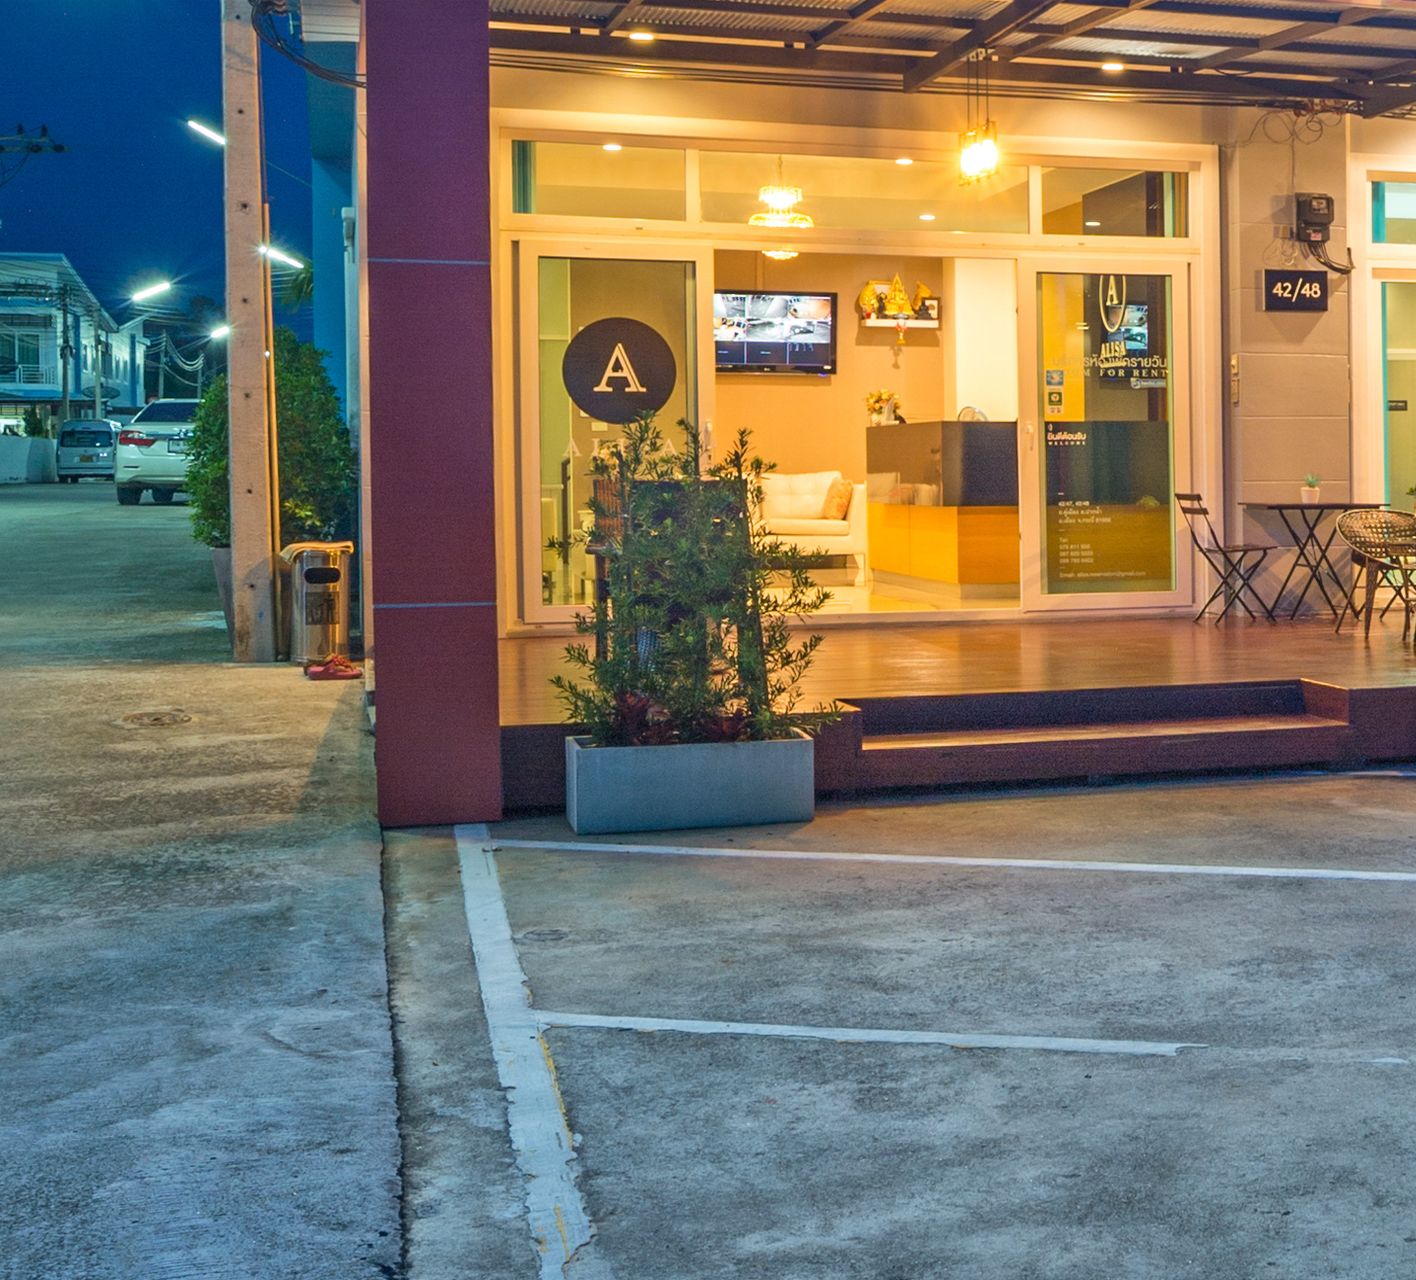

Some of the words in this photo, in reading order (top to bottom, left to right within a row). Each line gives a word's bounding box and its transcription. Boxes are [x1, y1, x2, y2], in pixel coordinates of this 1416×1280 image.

[1272, 277, 1321, 302] 42/48
[1100, 341, 1127, 359] ALISA
[592, 342, 647, 393] A
[1099, 368, 1125, 377] FOR
[1132, 368, 1167, 377] RENT
